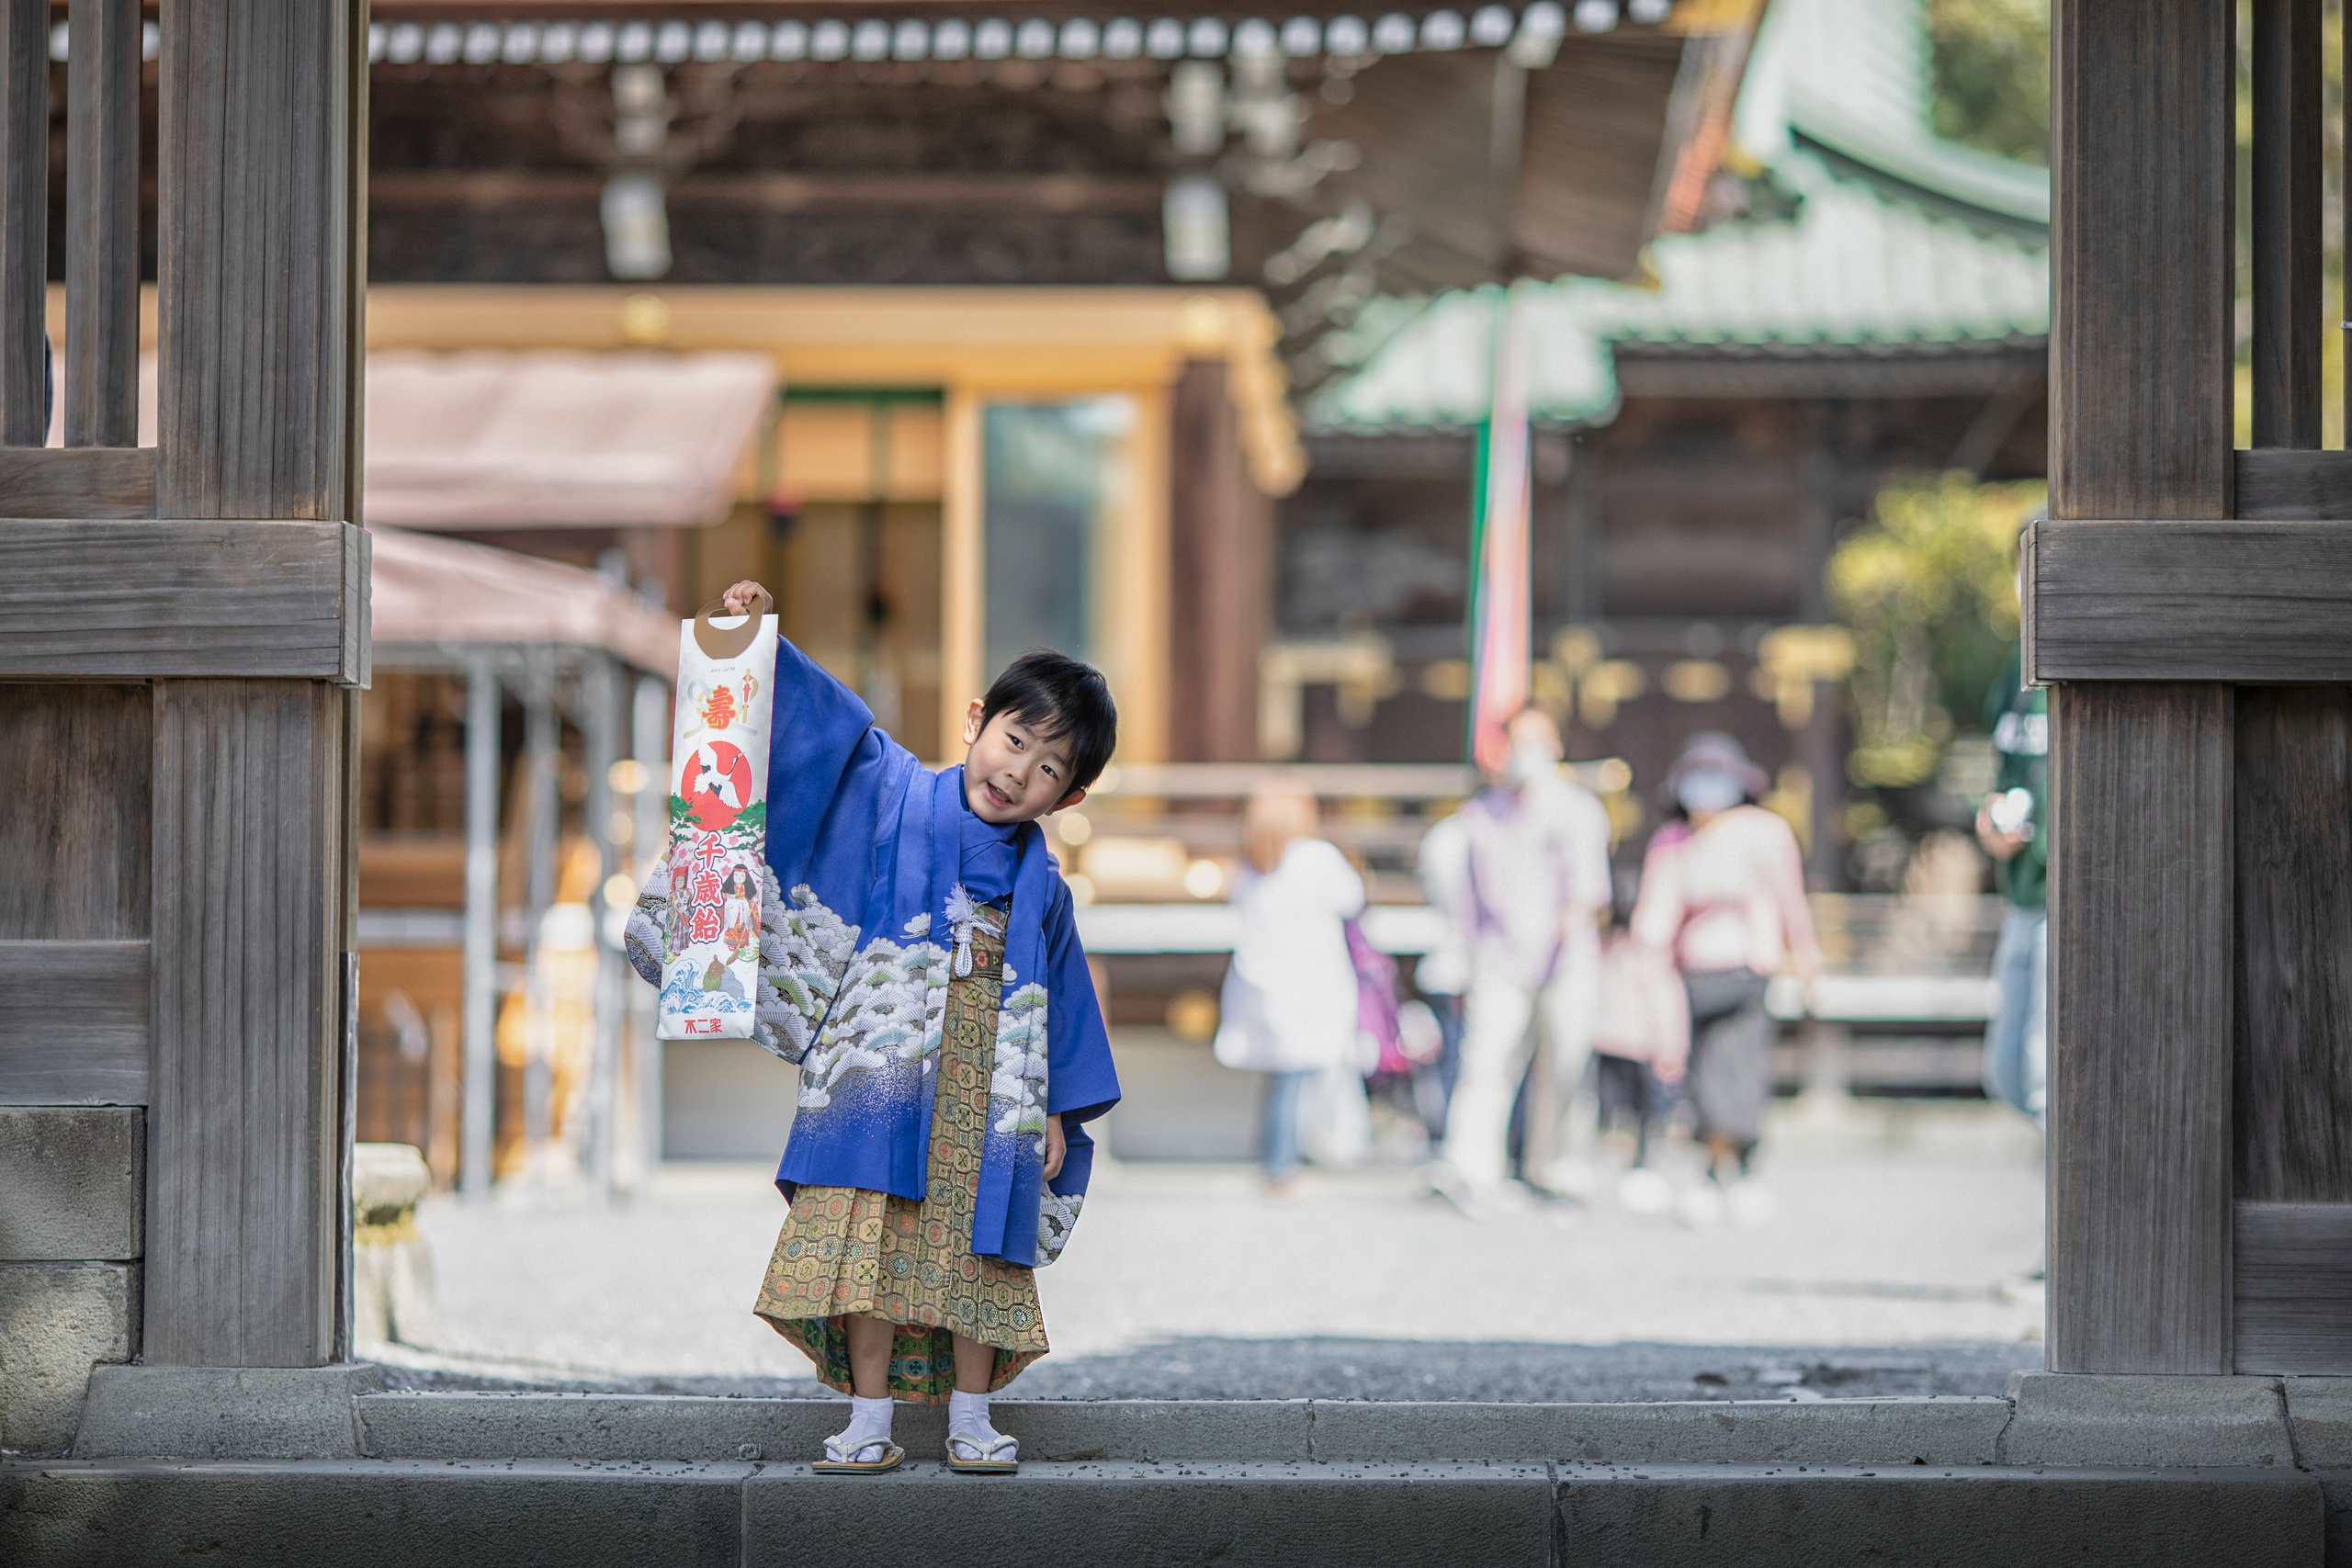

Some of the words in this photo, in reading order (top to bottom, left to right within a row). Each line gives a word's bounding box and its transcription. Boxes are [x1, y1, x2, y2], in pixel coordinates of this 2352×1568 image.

[691, 832, 724, 942] 千歳飴
[684, 1017, 723, 1034] 不二家
